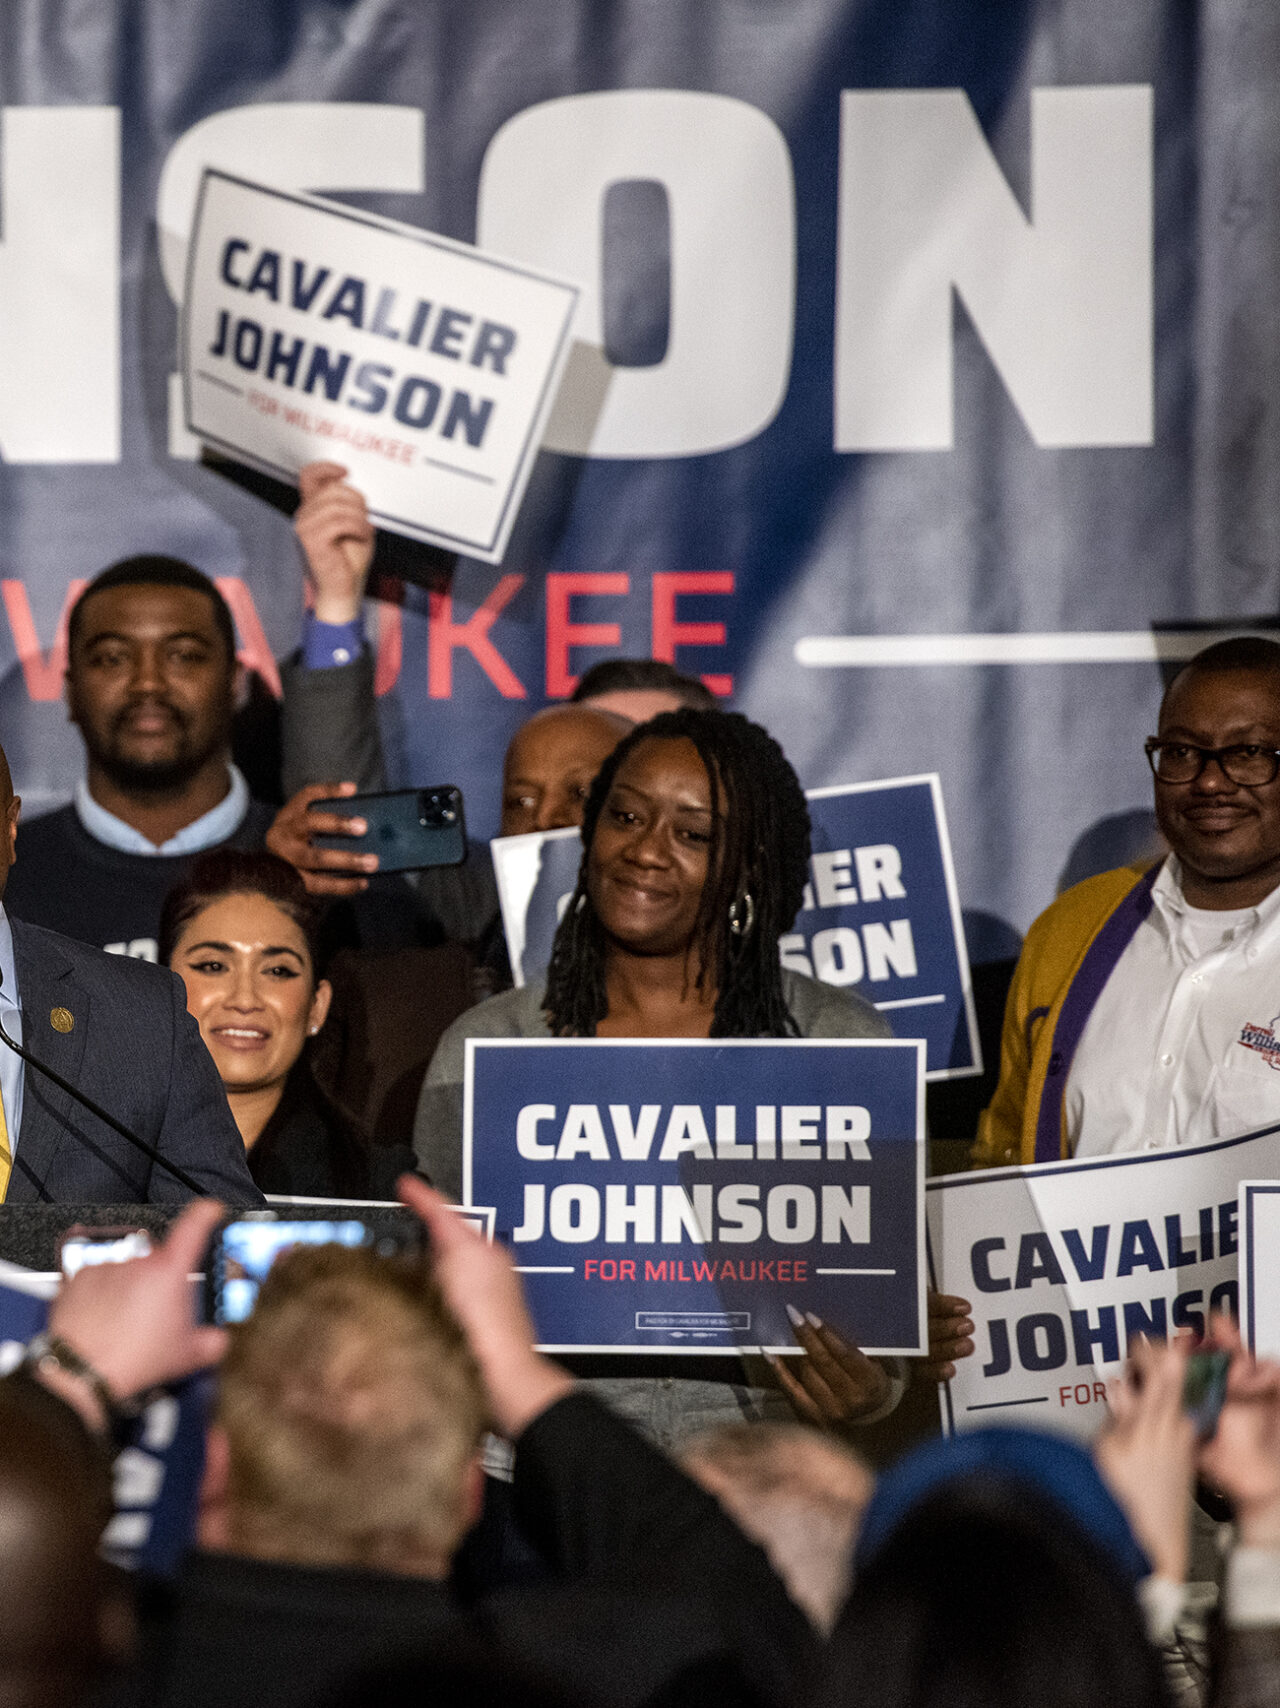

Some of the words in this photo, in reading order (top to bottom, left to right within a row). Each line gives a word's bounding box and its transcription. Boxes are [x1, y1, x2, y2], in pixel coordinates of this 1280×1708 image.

[220, 237, 518, 377] CAVALIER
[209, 309, 496, 449] JOHNSON
[515, 1103, 873, 1162] CAVALIER
[512, 1183, 872, 1245] JOHNSON
[583, 1259, 636, 1281] FOR
[644, 1259, 808, 1283] MILWAUKEE
